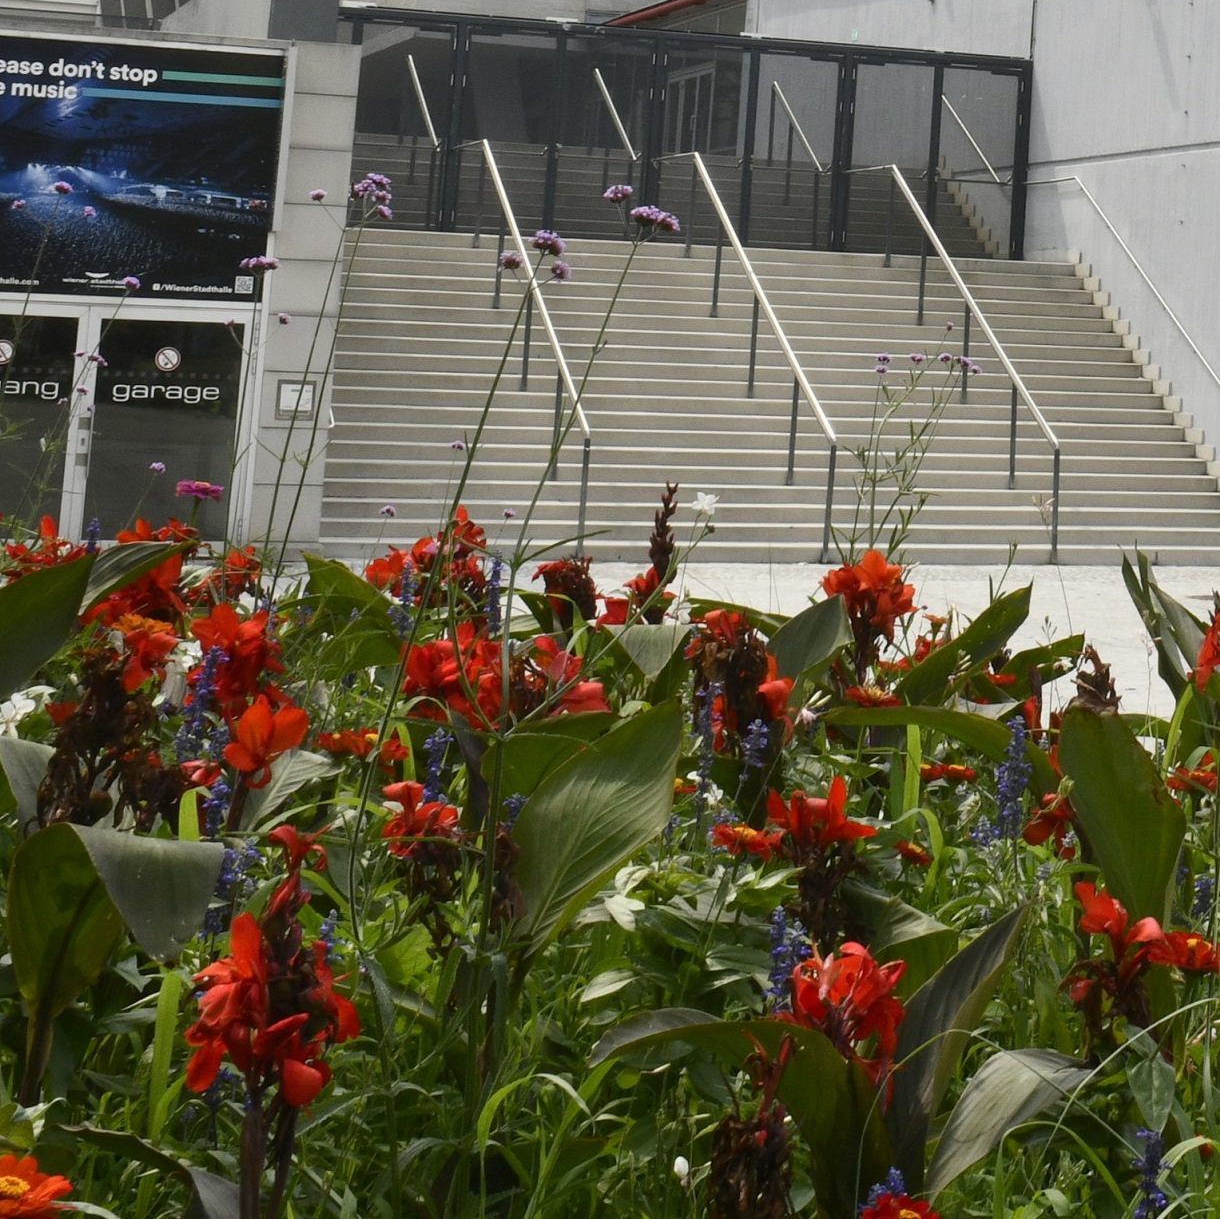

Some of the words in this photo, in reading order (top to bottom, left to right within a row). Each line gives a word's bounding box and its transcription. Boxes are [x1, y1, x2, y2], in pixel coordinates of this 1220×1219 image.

[49, 58, 105, 80] don't
[110, 64, 158, 87] stop
[11, 80, 78, 100] music
[0, 380, 60, 400] ang
[112, 384, 220, 404] garage
